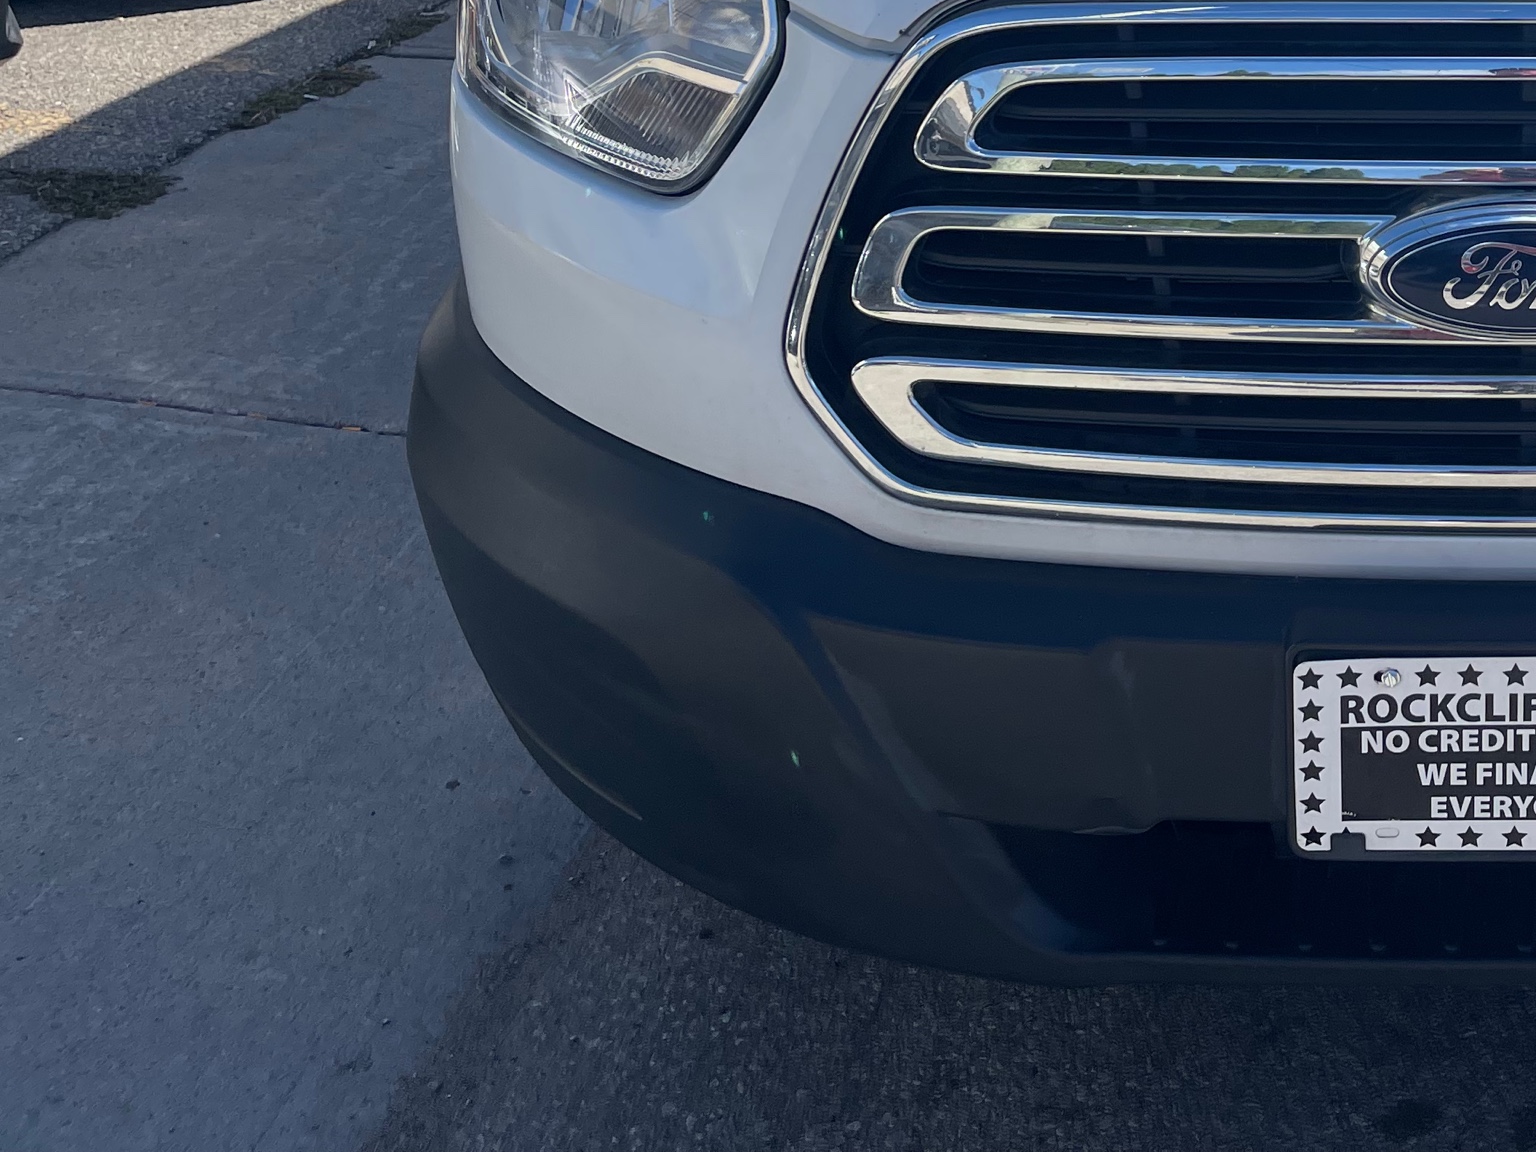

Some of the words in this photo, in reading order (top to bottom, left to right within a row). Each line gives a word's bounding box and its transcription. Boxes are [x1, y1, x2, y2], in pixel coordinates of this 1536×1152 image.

[1360, 729, 1411, 754] NO
[1418, 727, 1536, 753] CREDIT
[1416, 762, 1467, 786] WE
